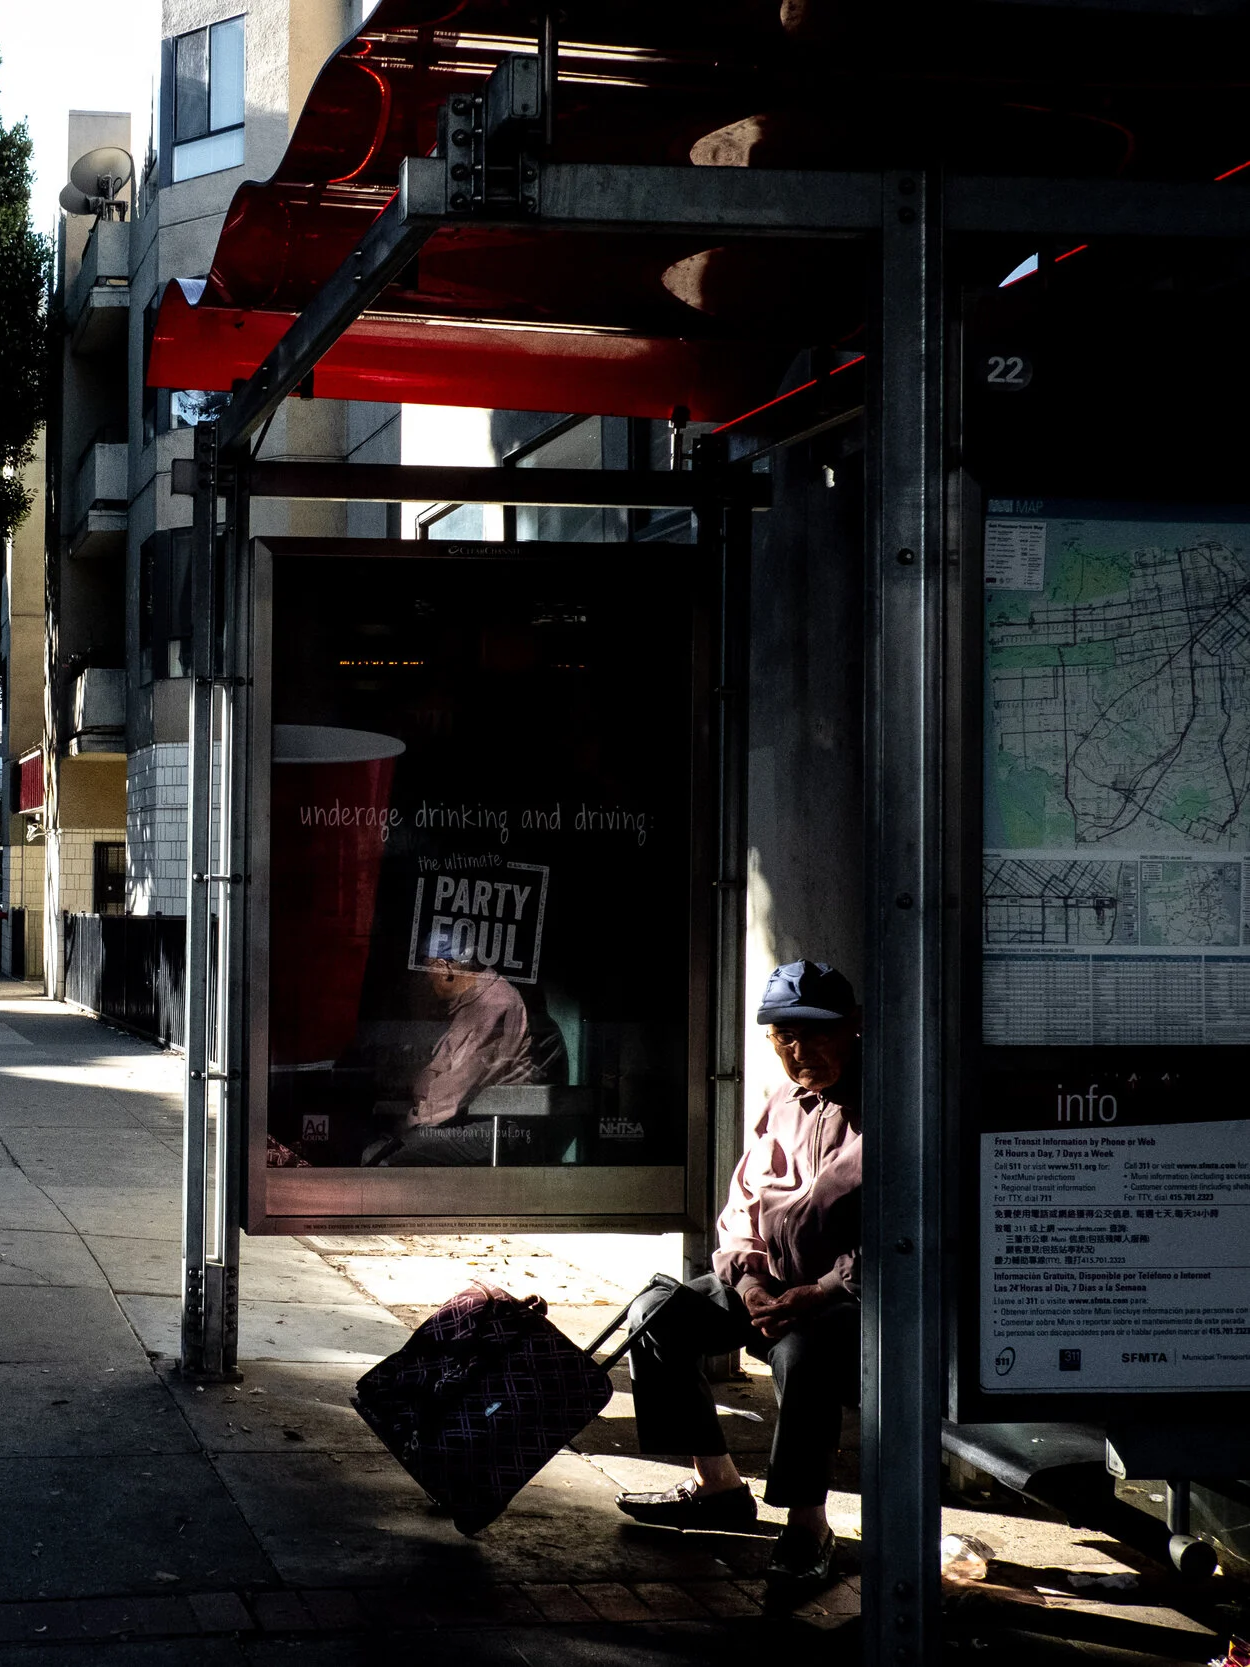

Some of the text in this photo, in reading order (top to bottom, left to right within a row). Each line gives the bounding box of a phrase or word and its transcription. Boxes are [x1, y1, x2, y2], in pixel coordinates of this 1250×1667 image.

[987, 356, 1023, 383] 22
[299, 798, 403, 841] underage
[414, 800, 510, 844] drinking
[521, 803, 562, 831] and
[417, 852, 503, 872] the ultimate
[434, 876, 532, 920] PARTY
[429, 915, 524, 969] FOUL
[1058, 1084, 1117, 1122] info
[304, 1120, 327, 1134] Ad
[599, 1122, 645, 1134] NHTSA
[418, 1126, 532, 1144] ultimatepartyfoul.org
[994, 1137, 1011, 1146] Free
[1014, 1137, 1040, 1146] Transit
[1042, 1137, 1088, 1146] Information
[1090, 1137, 1100, 1147] by
[1100, 1137, 1126, 1146] Phone
[1137, 1137, 1156, 1146] Web
[1037, 1150, 1054, 1159] Day,
[1062, 1150, 1082, 1159] Days
[1048, 1163, 1097, 1171] www.511.org
[1036, 1174, 1075, 1182] predictions
[1001, 1184, 1031, 1192] Regional
[994, 1272, 1040, 1280] Información
[1079, 1272, 1120, 1281] Disponible
[1138, 1271, 1172, 1279] Teléfono
[1180, 1271, 1212, 1279] Internet
[1064, 1351, 1080, 1360] 311
[1121, 1353, 1168, 1363] SFMTA
[996, 1358, 1010, 1366] 511
